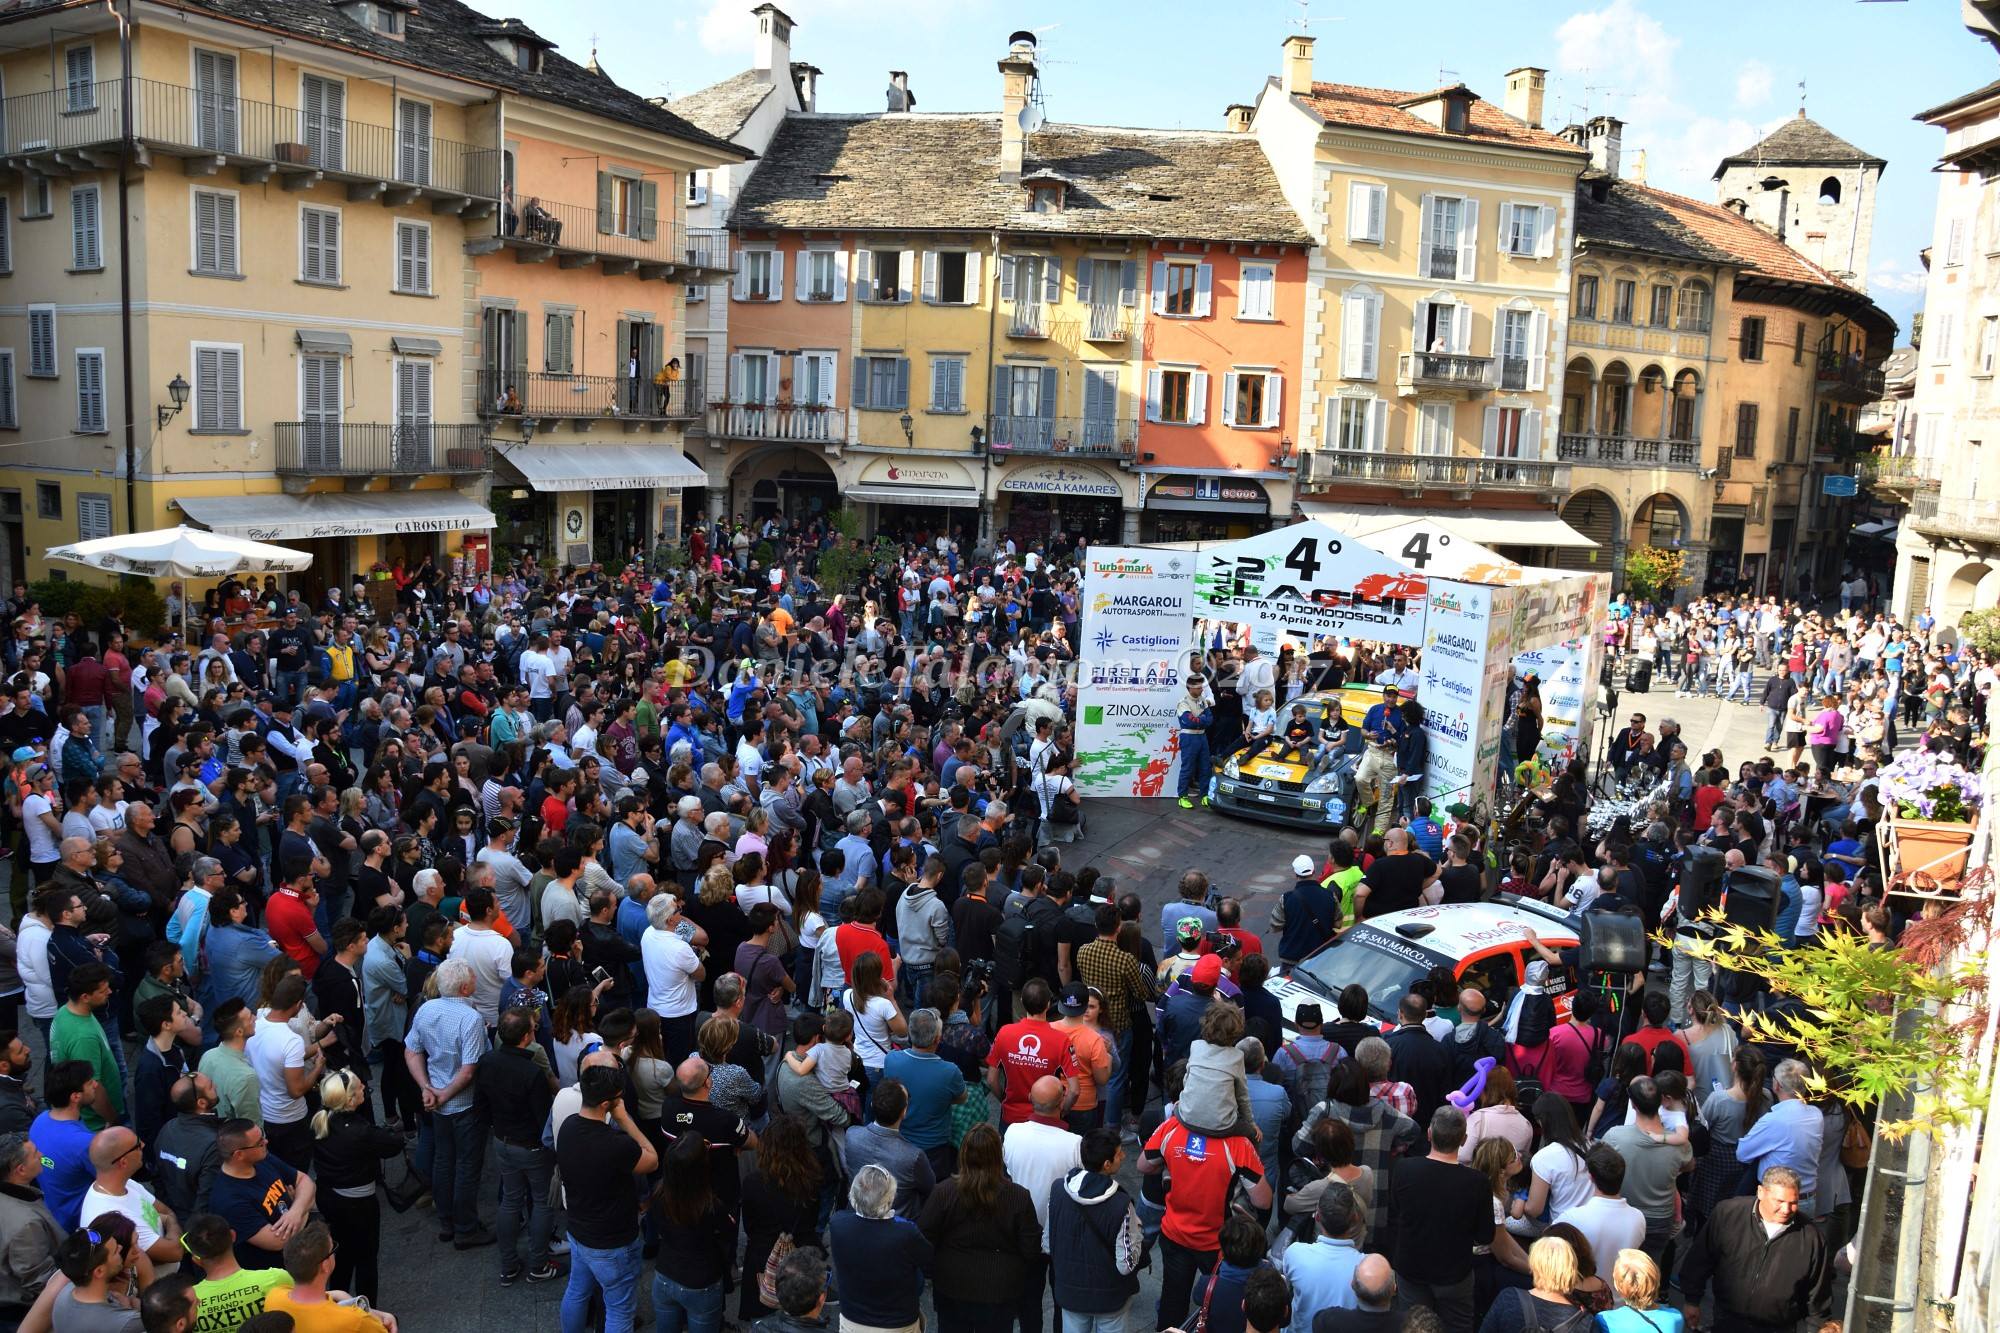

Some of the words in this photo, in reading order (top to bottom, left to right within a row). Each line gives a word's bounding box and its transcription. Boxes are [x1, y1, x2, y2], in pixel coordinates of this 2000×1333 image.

[1004, 480, 1061, 492] CERAMICA
[1063, 483, 1117, 495] KAMARES
[248, 528, 282, 540] Café
[305, 526, 331, 537] Ice
[331, 525, 374, 536] Cream
[395, 519, 470, 533] CAROSELLO
[1284, 537, 1342, 582] 4°
[1092, 561, 1153, 574] Turbomark
[1209, 556, 1233, 607] RALLY
[1113, 595, 1182, 608] MARGAROLI
[1101, 608, 1163, 617] AUTOTRASPORTI
[1276, 602, 1289, 613] DI
[1294, 605, 1403, 626] DOMODOSSOLA
[1260, 612, 1277, 622] 8-9
[1278, 614, 1313, 627] Aprile
[1316, 618, 1345, 629] 2017
[1121, 635, 1180, 647] Castiglioni
[1437, 632, 1477, 653] MARGAROLI
[1091, 666, 1142, 677] FIRST
[1139, 677, 1175, 686] ITALIA
[1441, 677, 1473, 697] Castiglioni
[1106, 704, 1150, 717] ZINOX
[1115, 721, 1170, 729] www.zinoxlaser.it
[1427, 825, 1437, 833] 24
[1368, 933, 1389, 946] SAN
[1388, 939, 1425, 961] MARCO
[1008, 1052, 1049, 1065] PRAMAC
[210, 1285, 260, 1305] FIGHTER
[207, 1300, 239, 1314] BRAND
